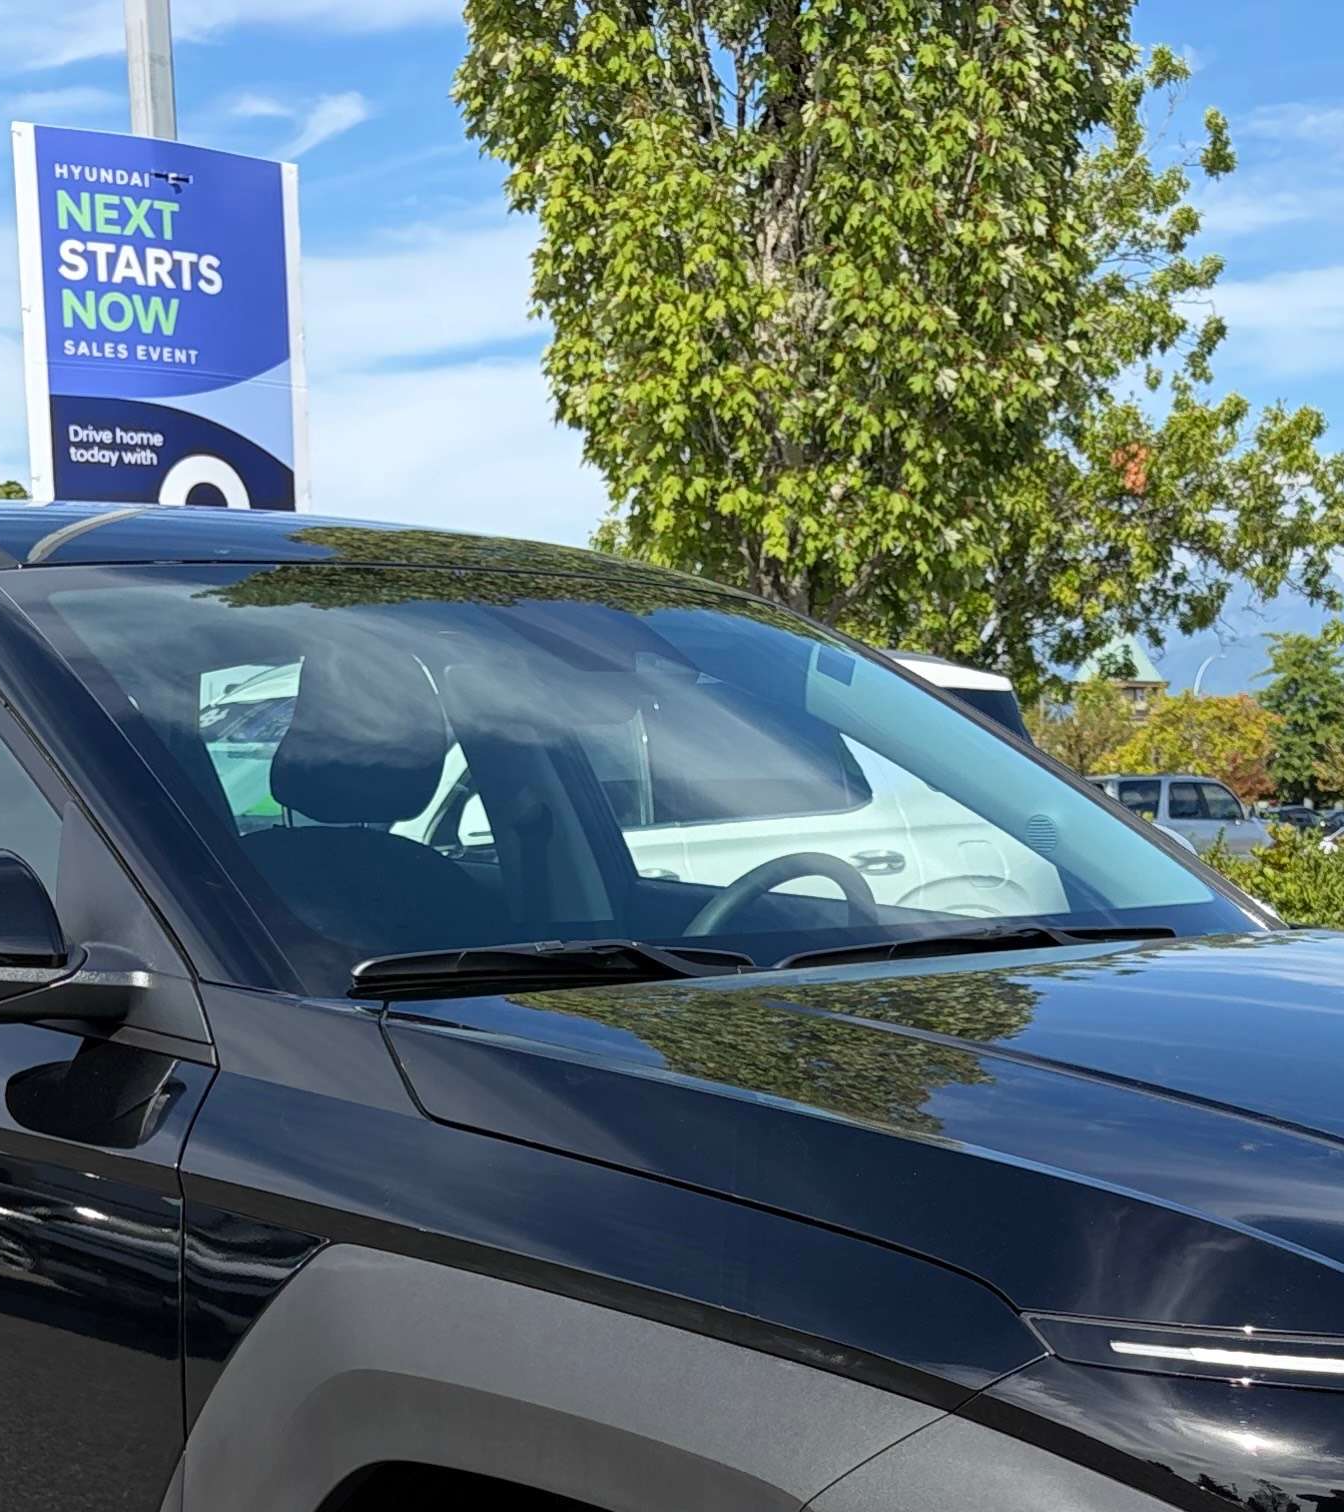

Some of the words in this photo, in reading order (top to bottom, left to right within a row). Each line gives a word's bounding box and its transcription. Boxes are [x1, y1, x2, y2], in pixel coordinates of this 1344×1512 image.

[54, 163, 151, 188] HYUNDAI
[57, 189, 180, 240] NEXT
[58, 239, 223, 295] STARTS
[61, 288, 179, 336] NOW
[63, 340, 128, 360] SALES
[136, 345, 198, 365] EVENT
[68, 424, 113, 444] Drive
[115, 427, 164, 447] home
[69, 446, 119, 467] today
[121, 449, 158, 466] with
